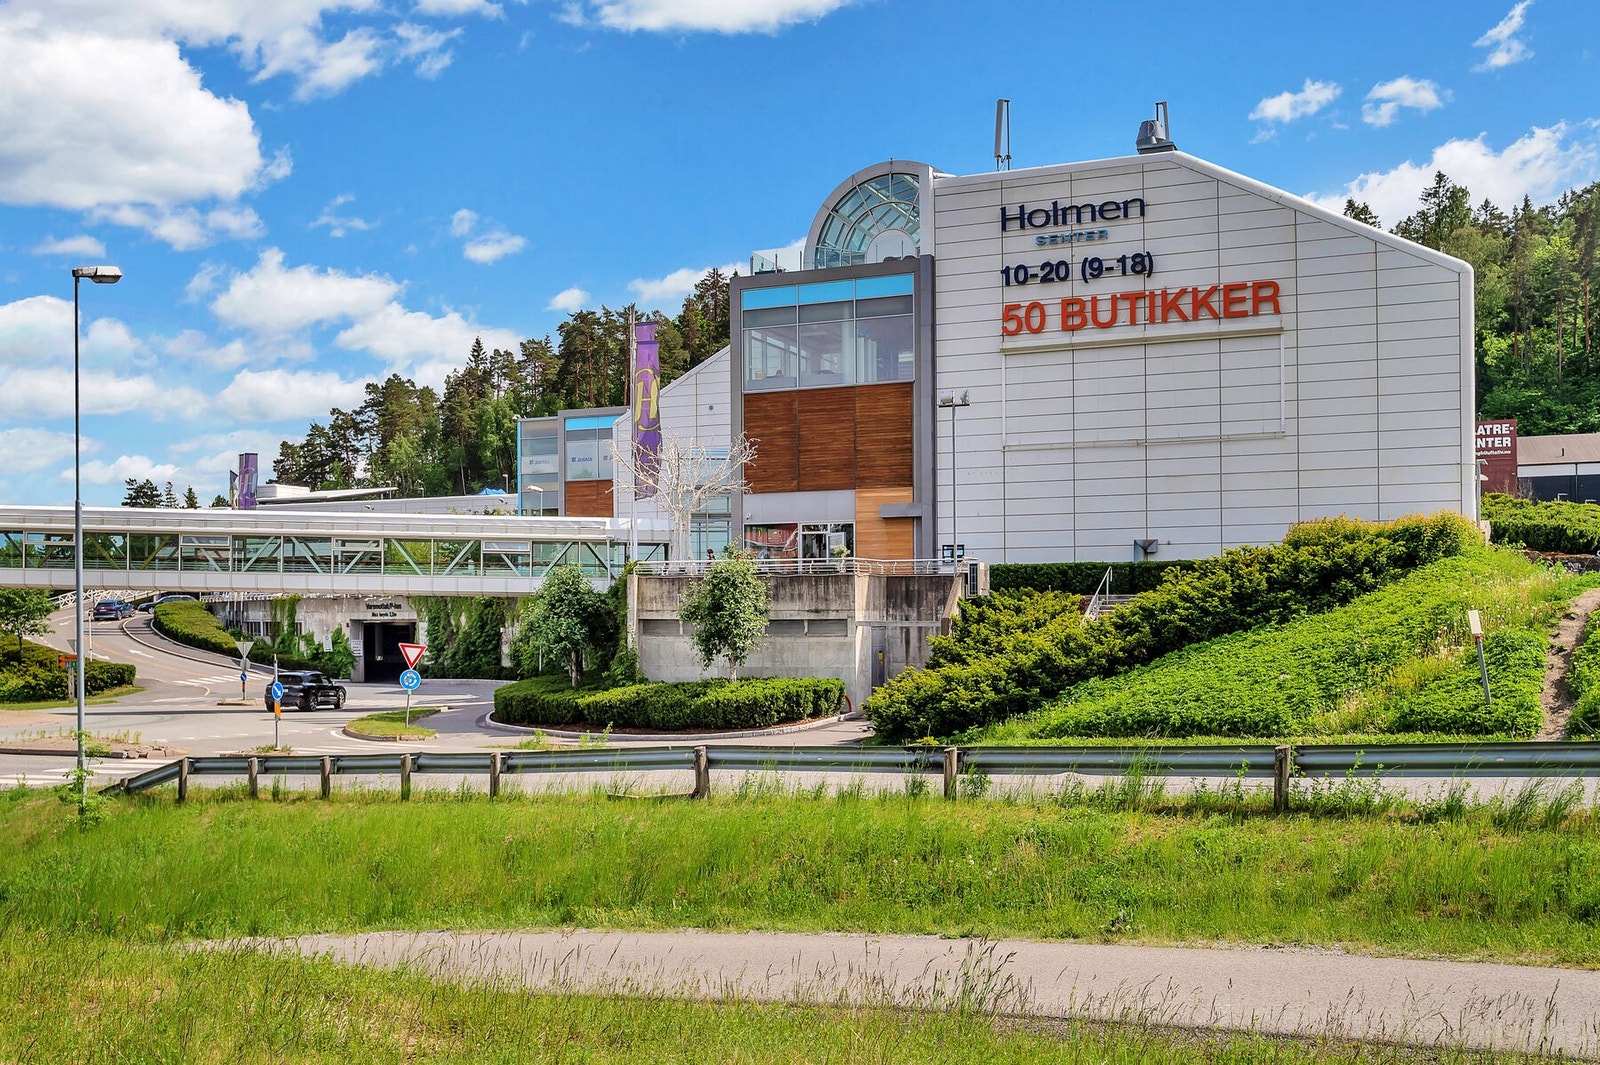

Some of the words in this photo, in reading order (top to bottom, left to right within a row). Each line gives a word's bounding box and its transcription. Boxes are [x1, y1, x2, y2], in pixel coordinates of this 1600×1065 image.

[1000, 197, 1145, 232] Holmen
[1035, 229, 1108, 246] SENTER
[1000, 260, 1070, 286] 10-20
[1080, 251, 1154, 283] (9-18)
[1001, 301, 1046, 336] 50
[1060, 280, 1281, 331] BUTIKKER
[1475, 424, 1514, 435] ATRE-
[1475, 437, 1511, 449] NTER
